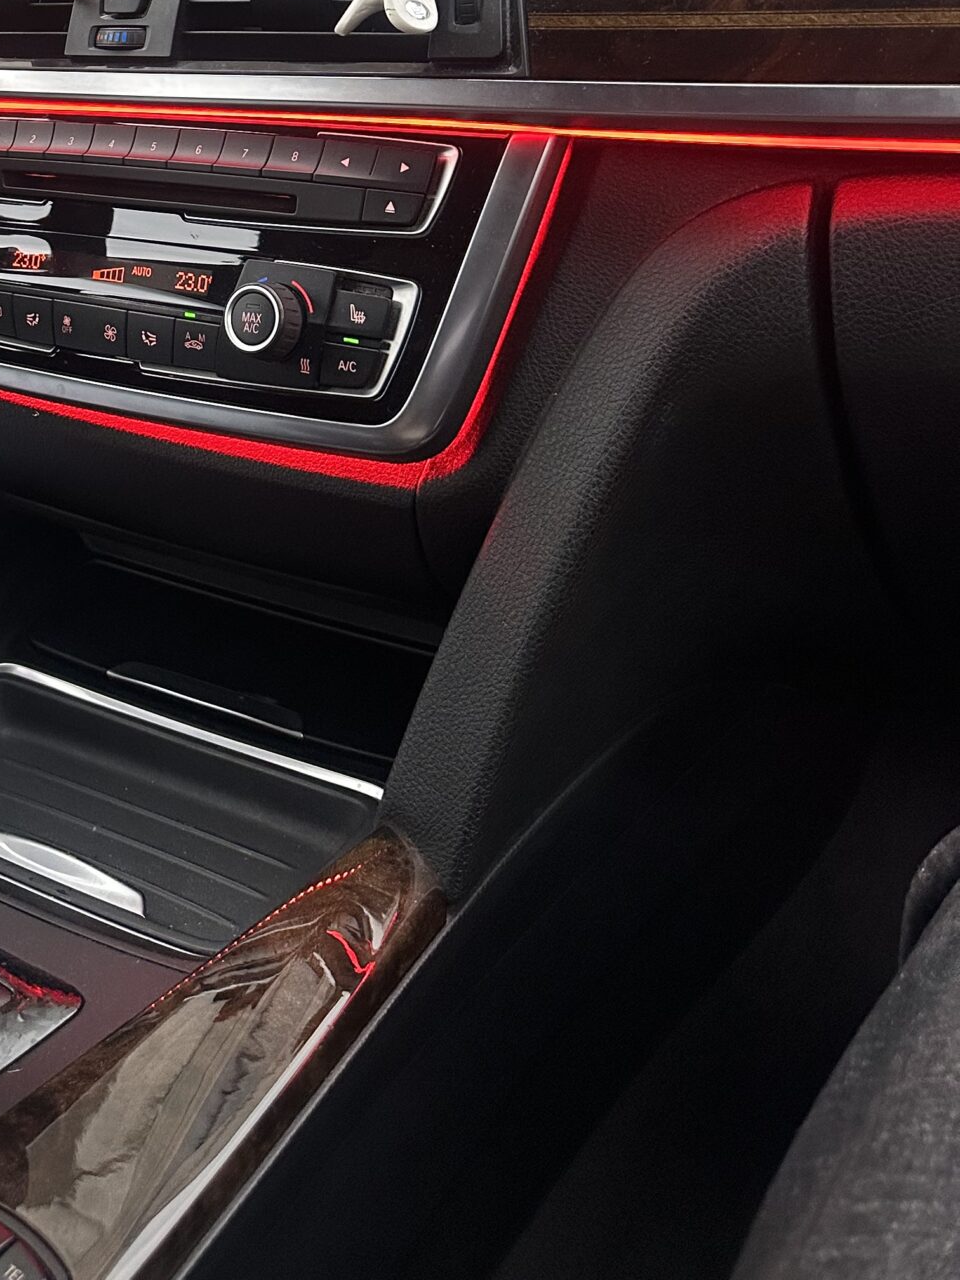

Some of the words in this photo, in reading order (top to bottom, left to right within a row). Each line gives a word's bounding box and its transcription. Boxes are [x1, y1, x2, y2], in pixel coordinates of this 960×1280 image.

[29, 134, 37, 144] 2
[67, 136, 75, 146] 3
[107, 139, 115, 149] 4
[150, 142, 158, 151] 5
[195, 145, 203, 155] 6
[242, 148, 249, 159] 7
[291, 151, 299, 162] 8
[131, 266, 152, 278] AUTO
[241, 312, 263, 324] MAX
[243, 322, 260, 335] A/C
[337, 359, 357, 373] A/C
